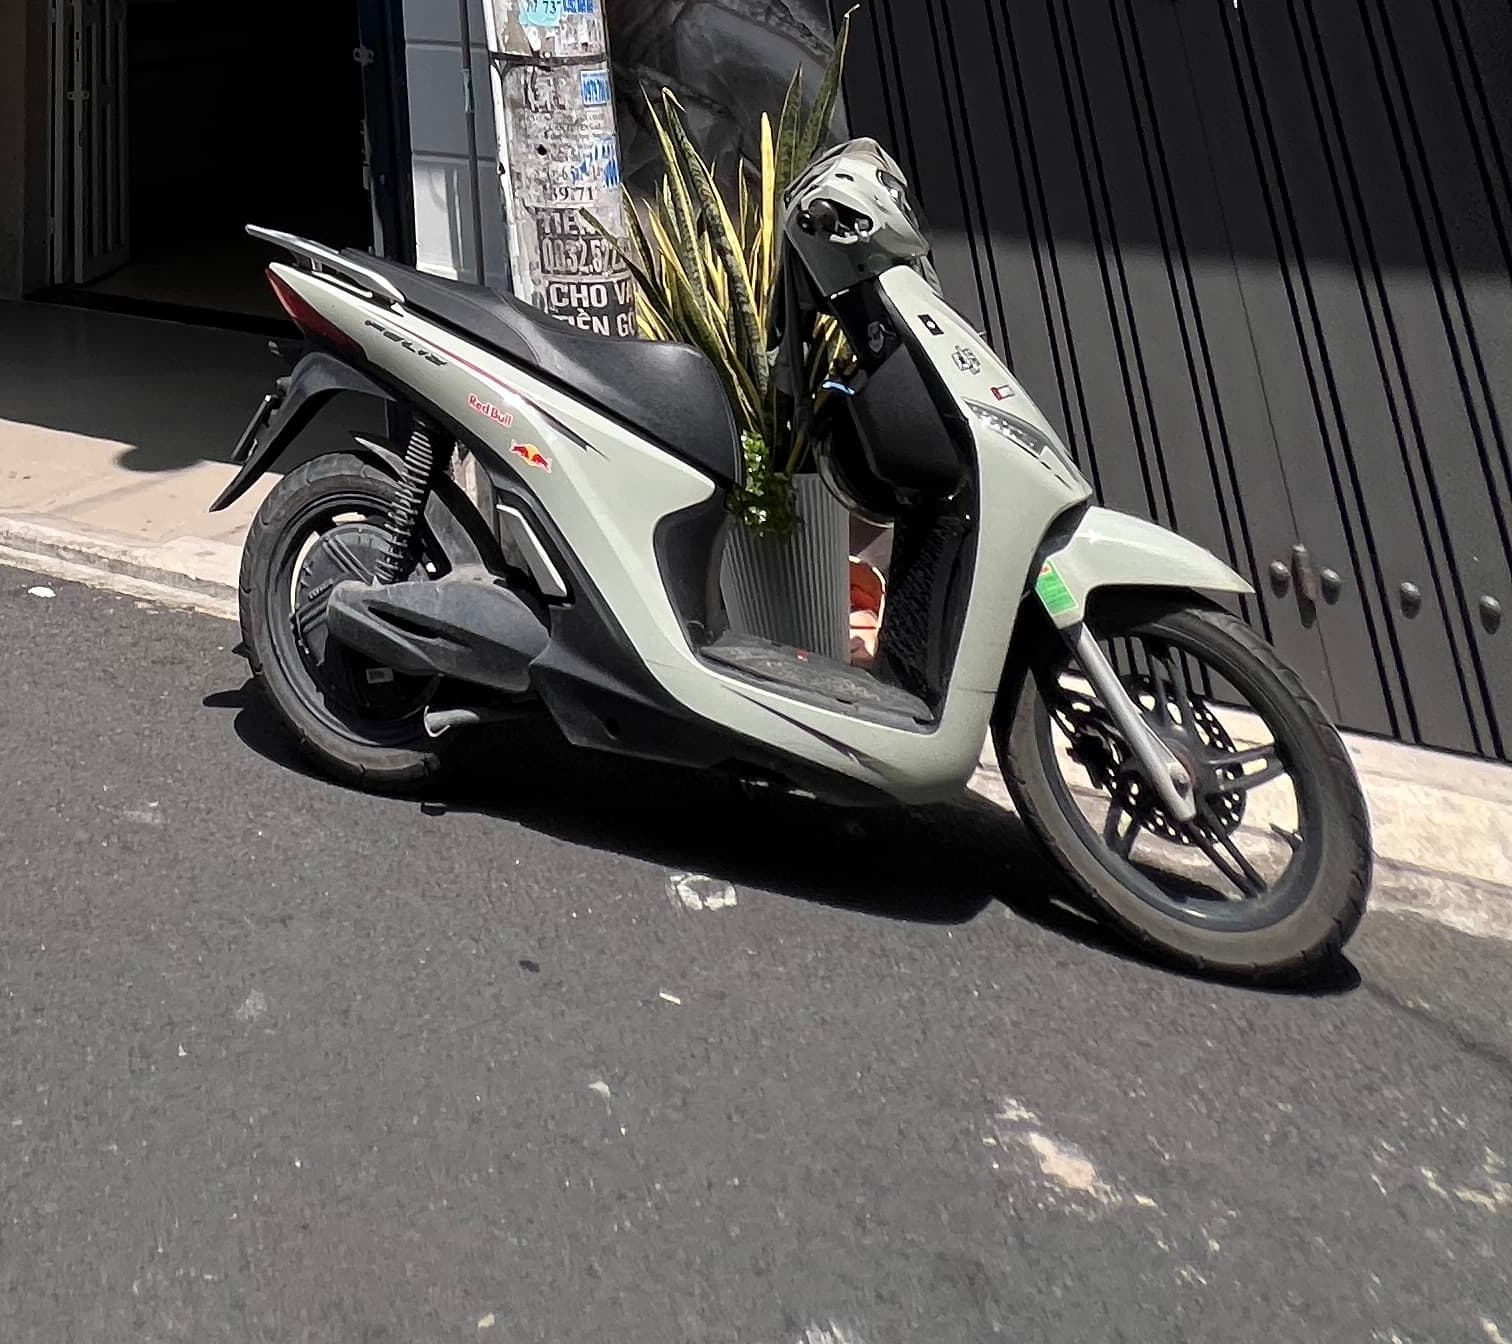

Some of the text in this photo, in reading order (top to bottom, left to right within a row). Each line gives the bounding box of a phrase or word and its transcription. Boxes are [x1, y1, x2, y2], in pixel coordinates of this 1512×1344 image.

[549, 283, 608, 308] CHO
[469, 395, 513, 428] Red Bull
